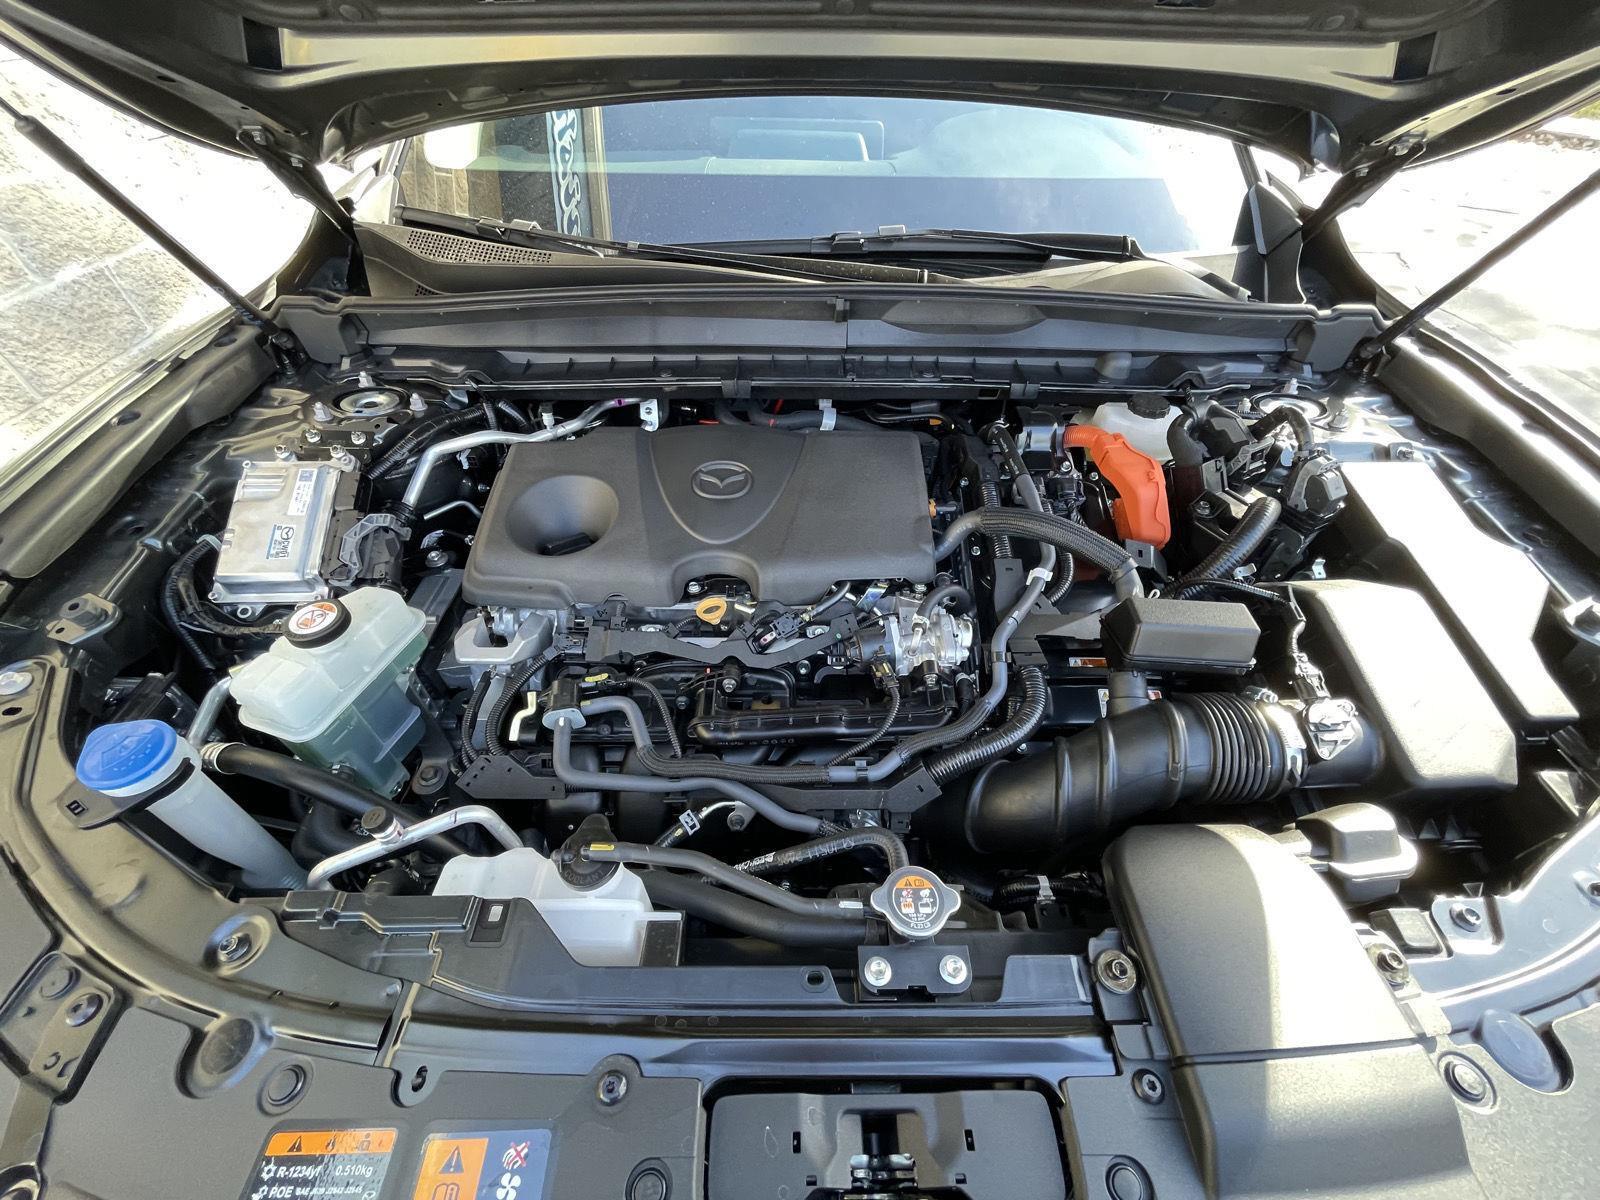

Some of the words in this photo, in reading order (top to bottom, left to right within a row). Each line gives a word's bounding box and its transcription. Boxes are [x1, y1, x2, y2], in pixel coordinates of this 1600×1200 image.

[276, 1165, 323, 1180] R-1234yf
[335, 1164, 374, 1178] 0.510kg
[268, 1185, 294, 1199] POE
